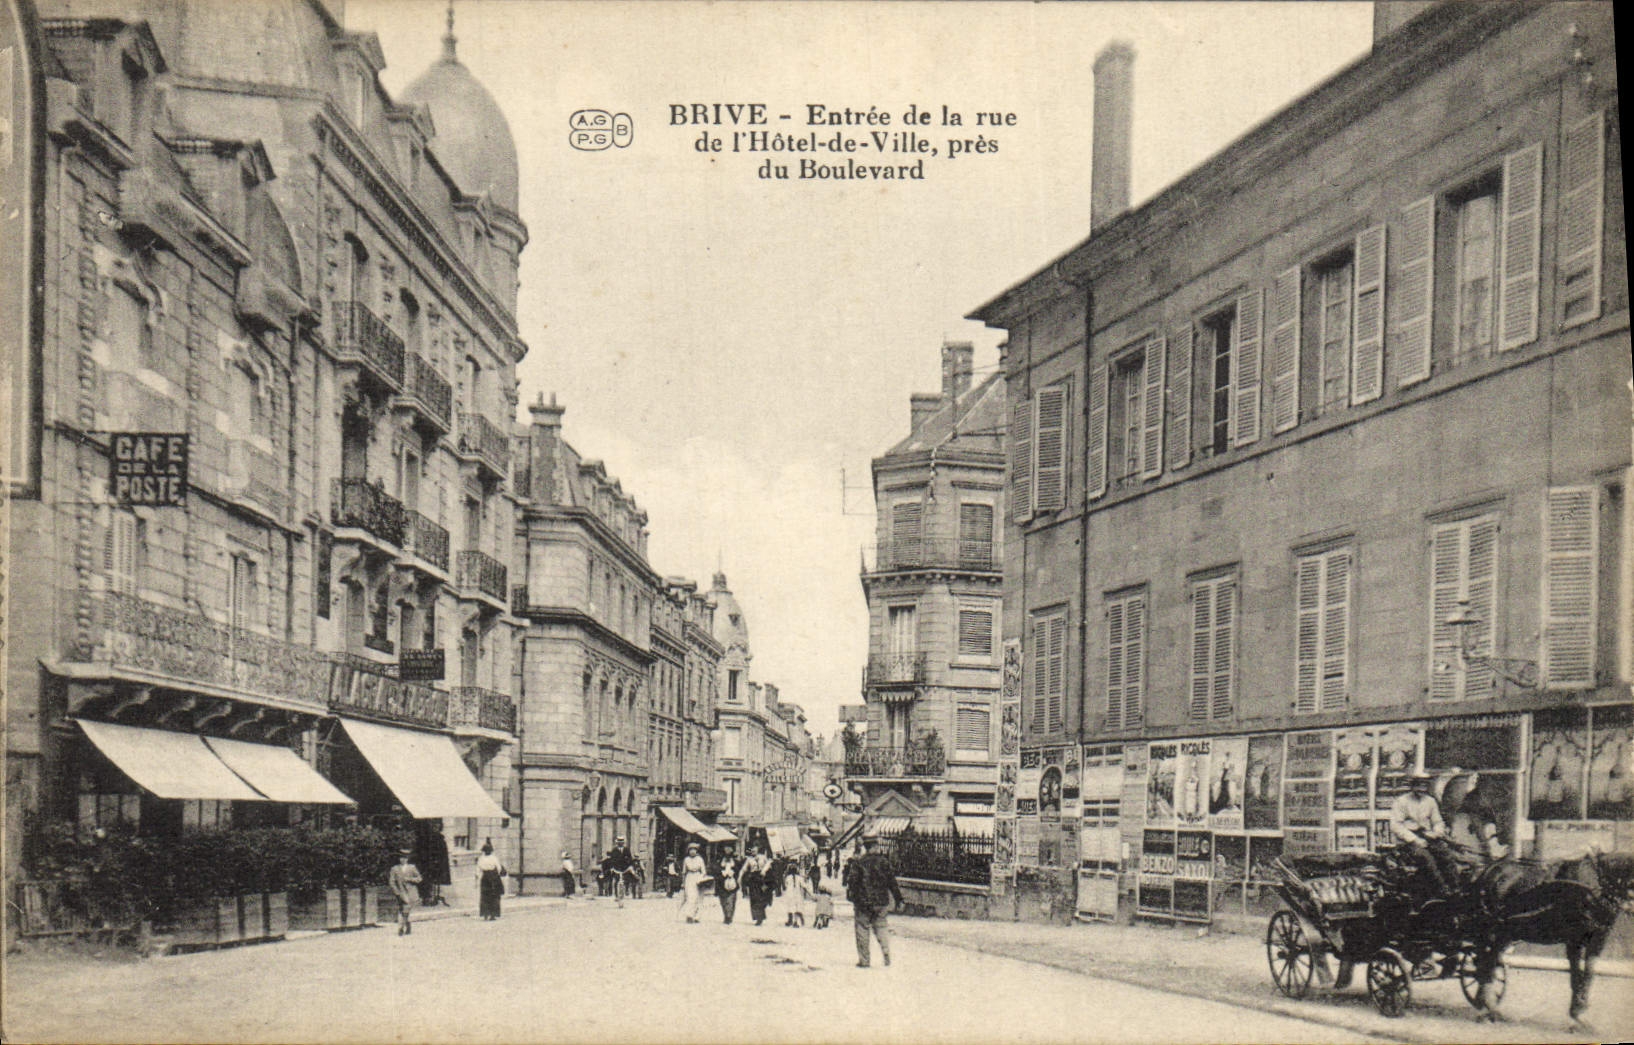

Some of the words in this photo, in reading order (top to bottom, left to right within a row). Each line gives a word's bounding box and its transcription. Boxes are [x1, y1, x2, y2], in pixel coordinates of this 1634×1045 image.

[118, 462, 146, 475] DE
[152, 463, 179, 475] LA
[116, 475, 181, 502] POSTE
